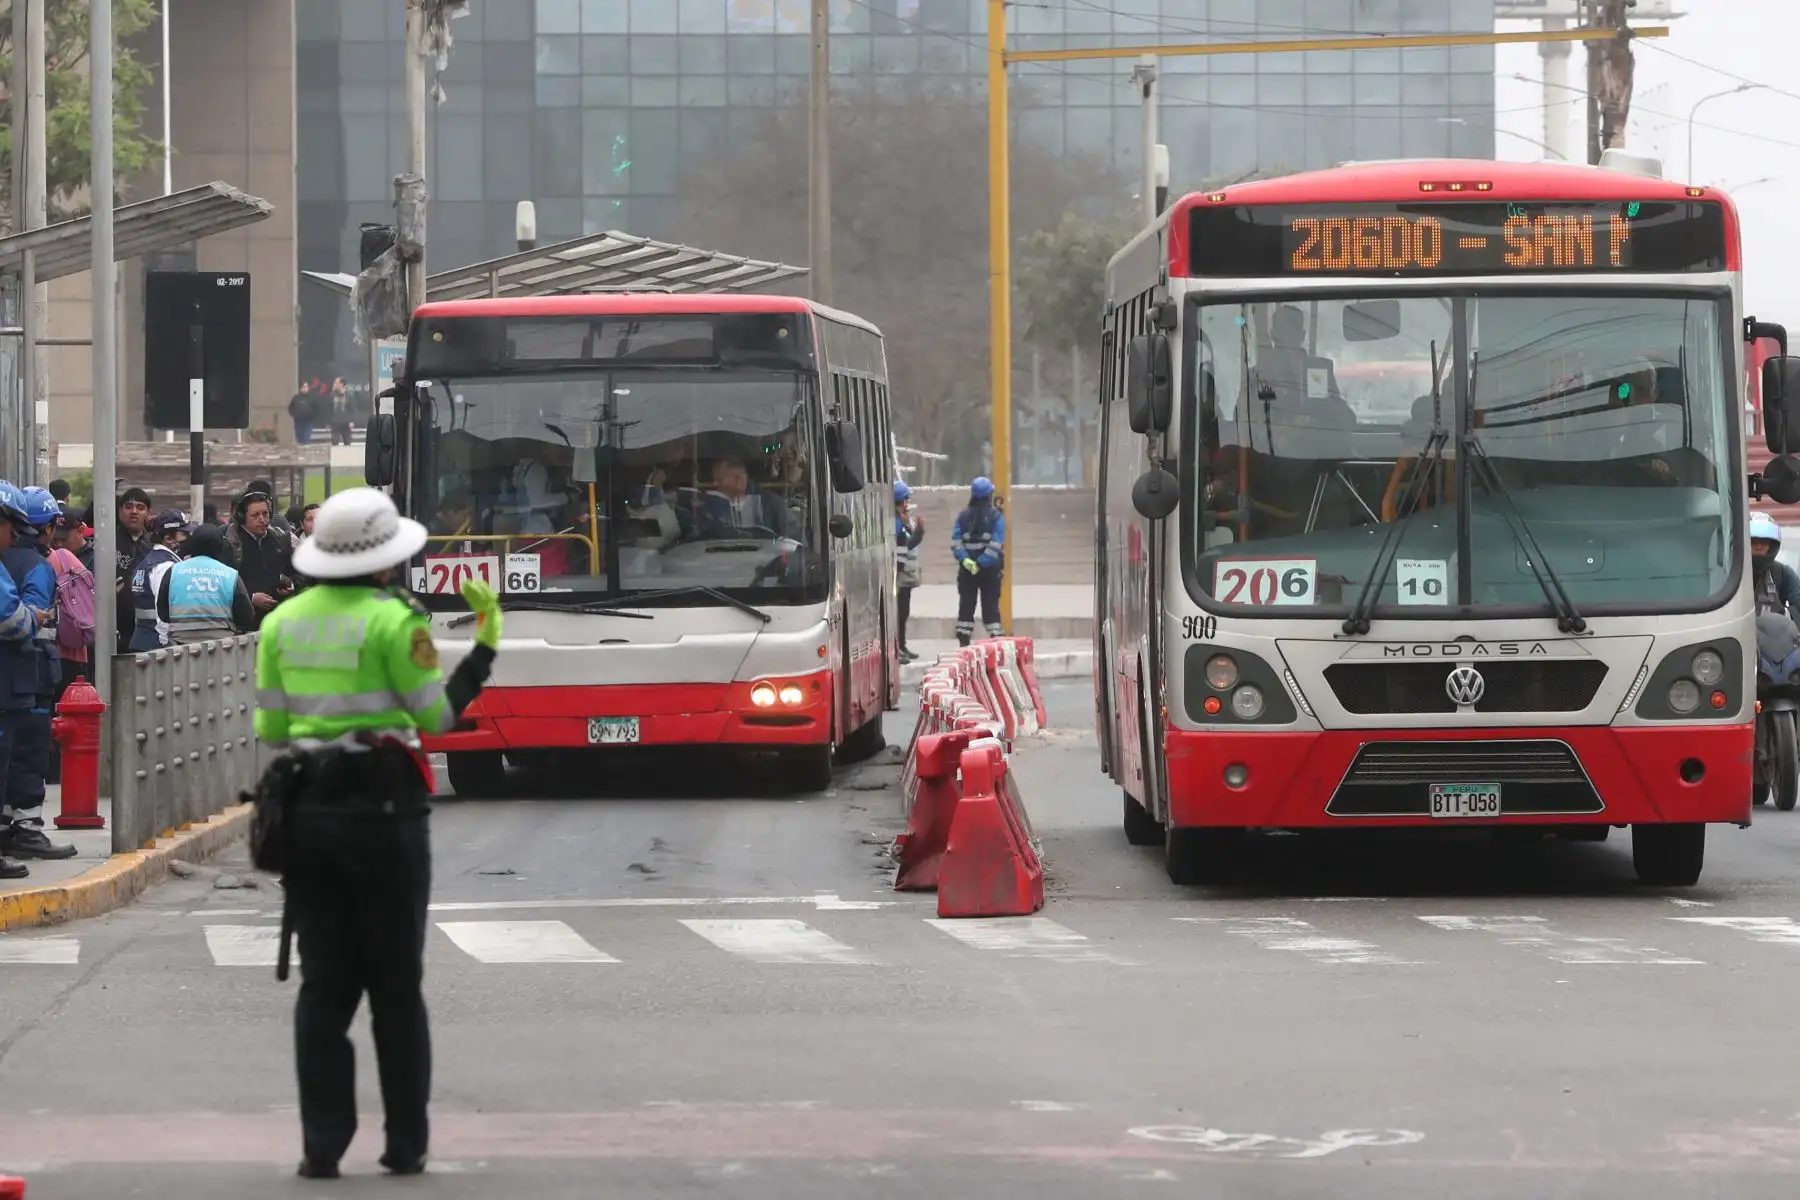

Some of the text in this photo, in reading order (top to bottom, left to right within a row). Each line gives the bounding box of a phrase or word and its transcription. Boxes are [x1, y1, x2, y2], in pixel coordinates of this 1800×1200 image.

[1504, 215, 1593, 267] SAN
[431, 562, 490, 594] 201
[507, 572, 538, 591] 66
[1221, 567, 1309, 606] 206
[1402, 577, 1442, 597] 10
[1182, 615, 1217, 640] 900
[1384, 643, 1547, 656] MODASA
[1433, 793, 1497, 813] BTT-058
